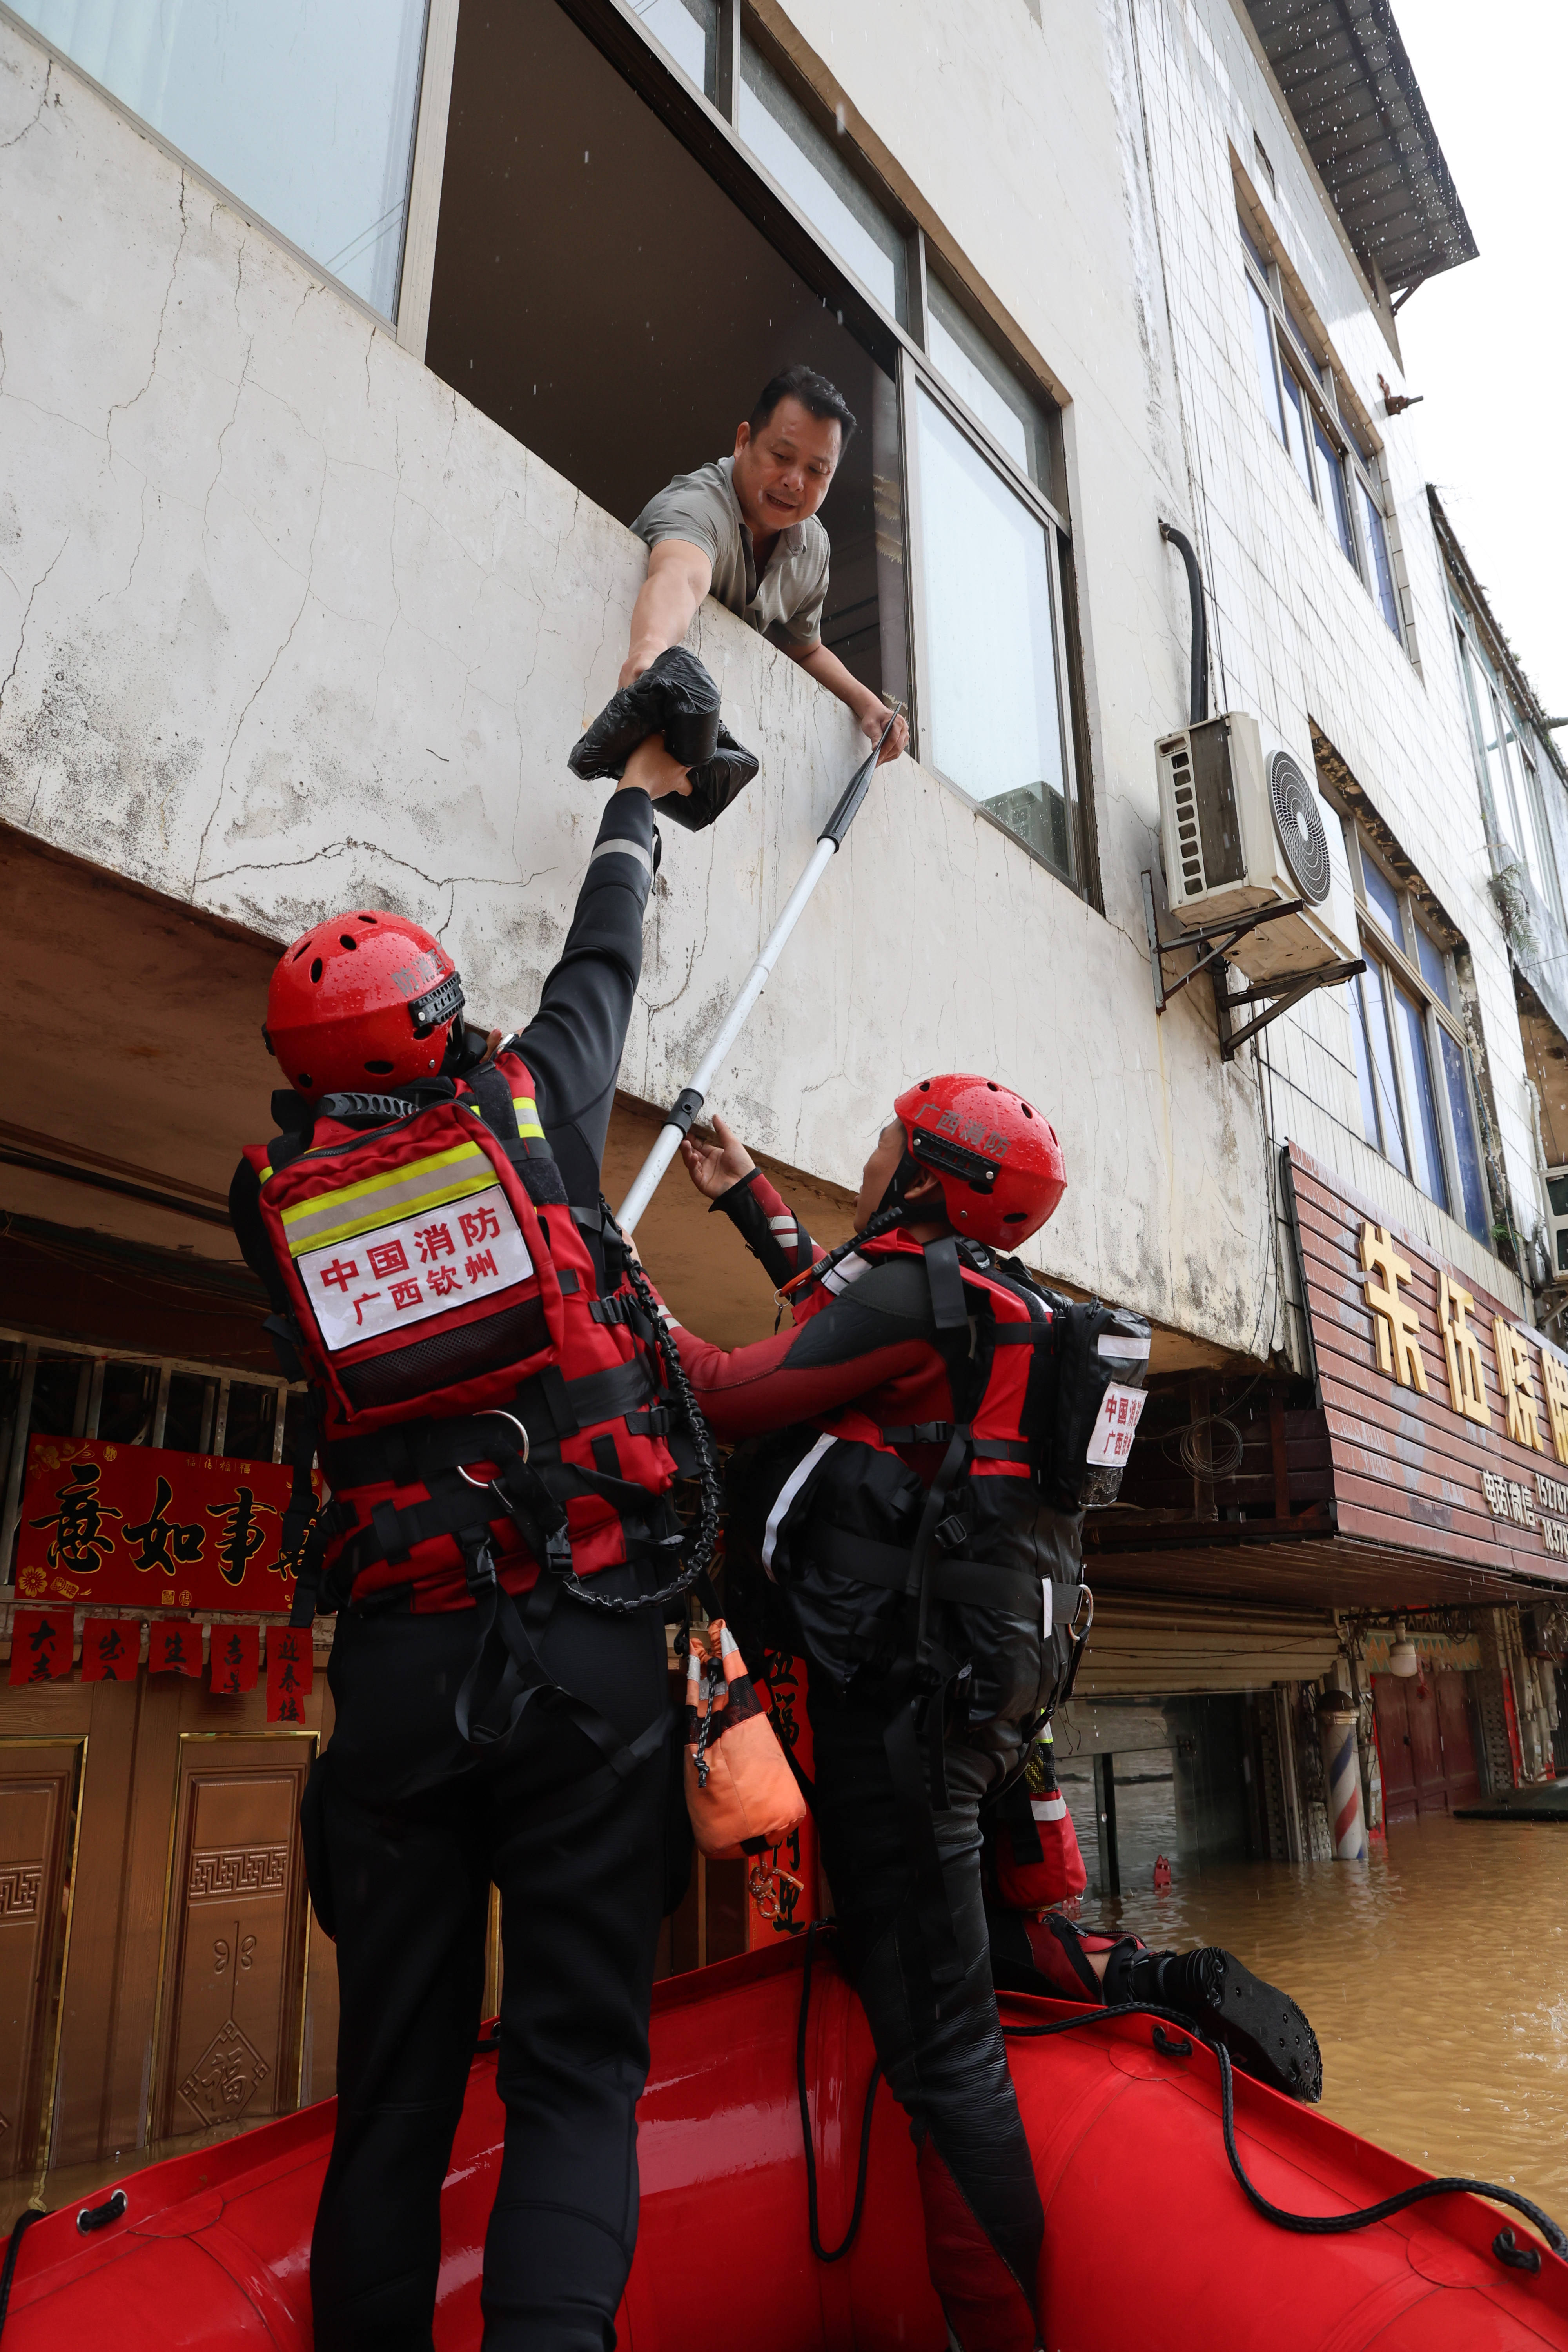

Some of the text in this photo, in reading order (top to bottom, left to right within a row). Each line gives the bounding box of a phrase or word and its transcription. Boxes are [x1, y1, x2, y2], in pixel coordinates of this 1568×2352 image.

[914, 1103, 1011, 1158] 广西消防
[320, 1206, 500, 1293] 中国消防
[352, 1249, 499, 1326] 广西钦州
[1534, 1473, 1568, 1515] 152787
[1542, 1518, 1568, 1556] 18378
[165, 1632, 187, 1671] 生
